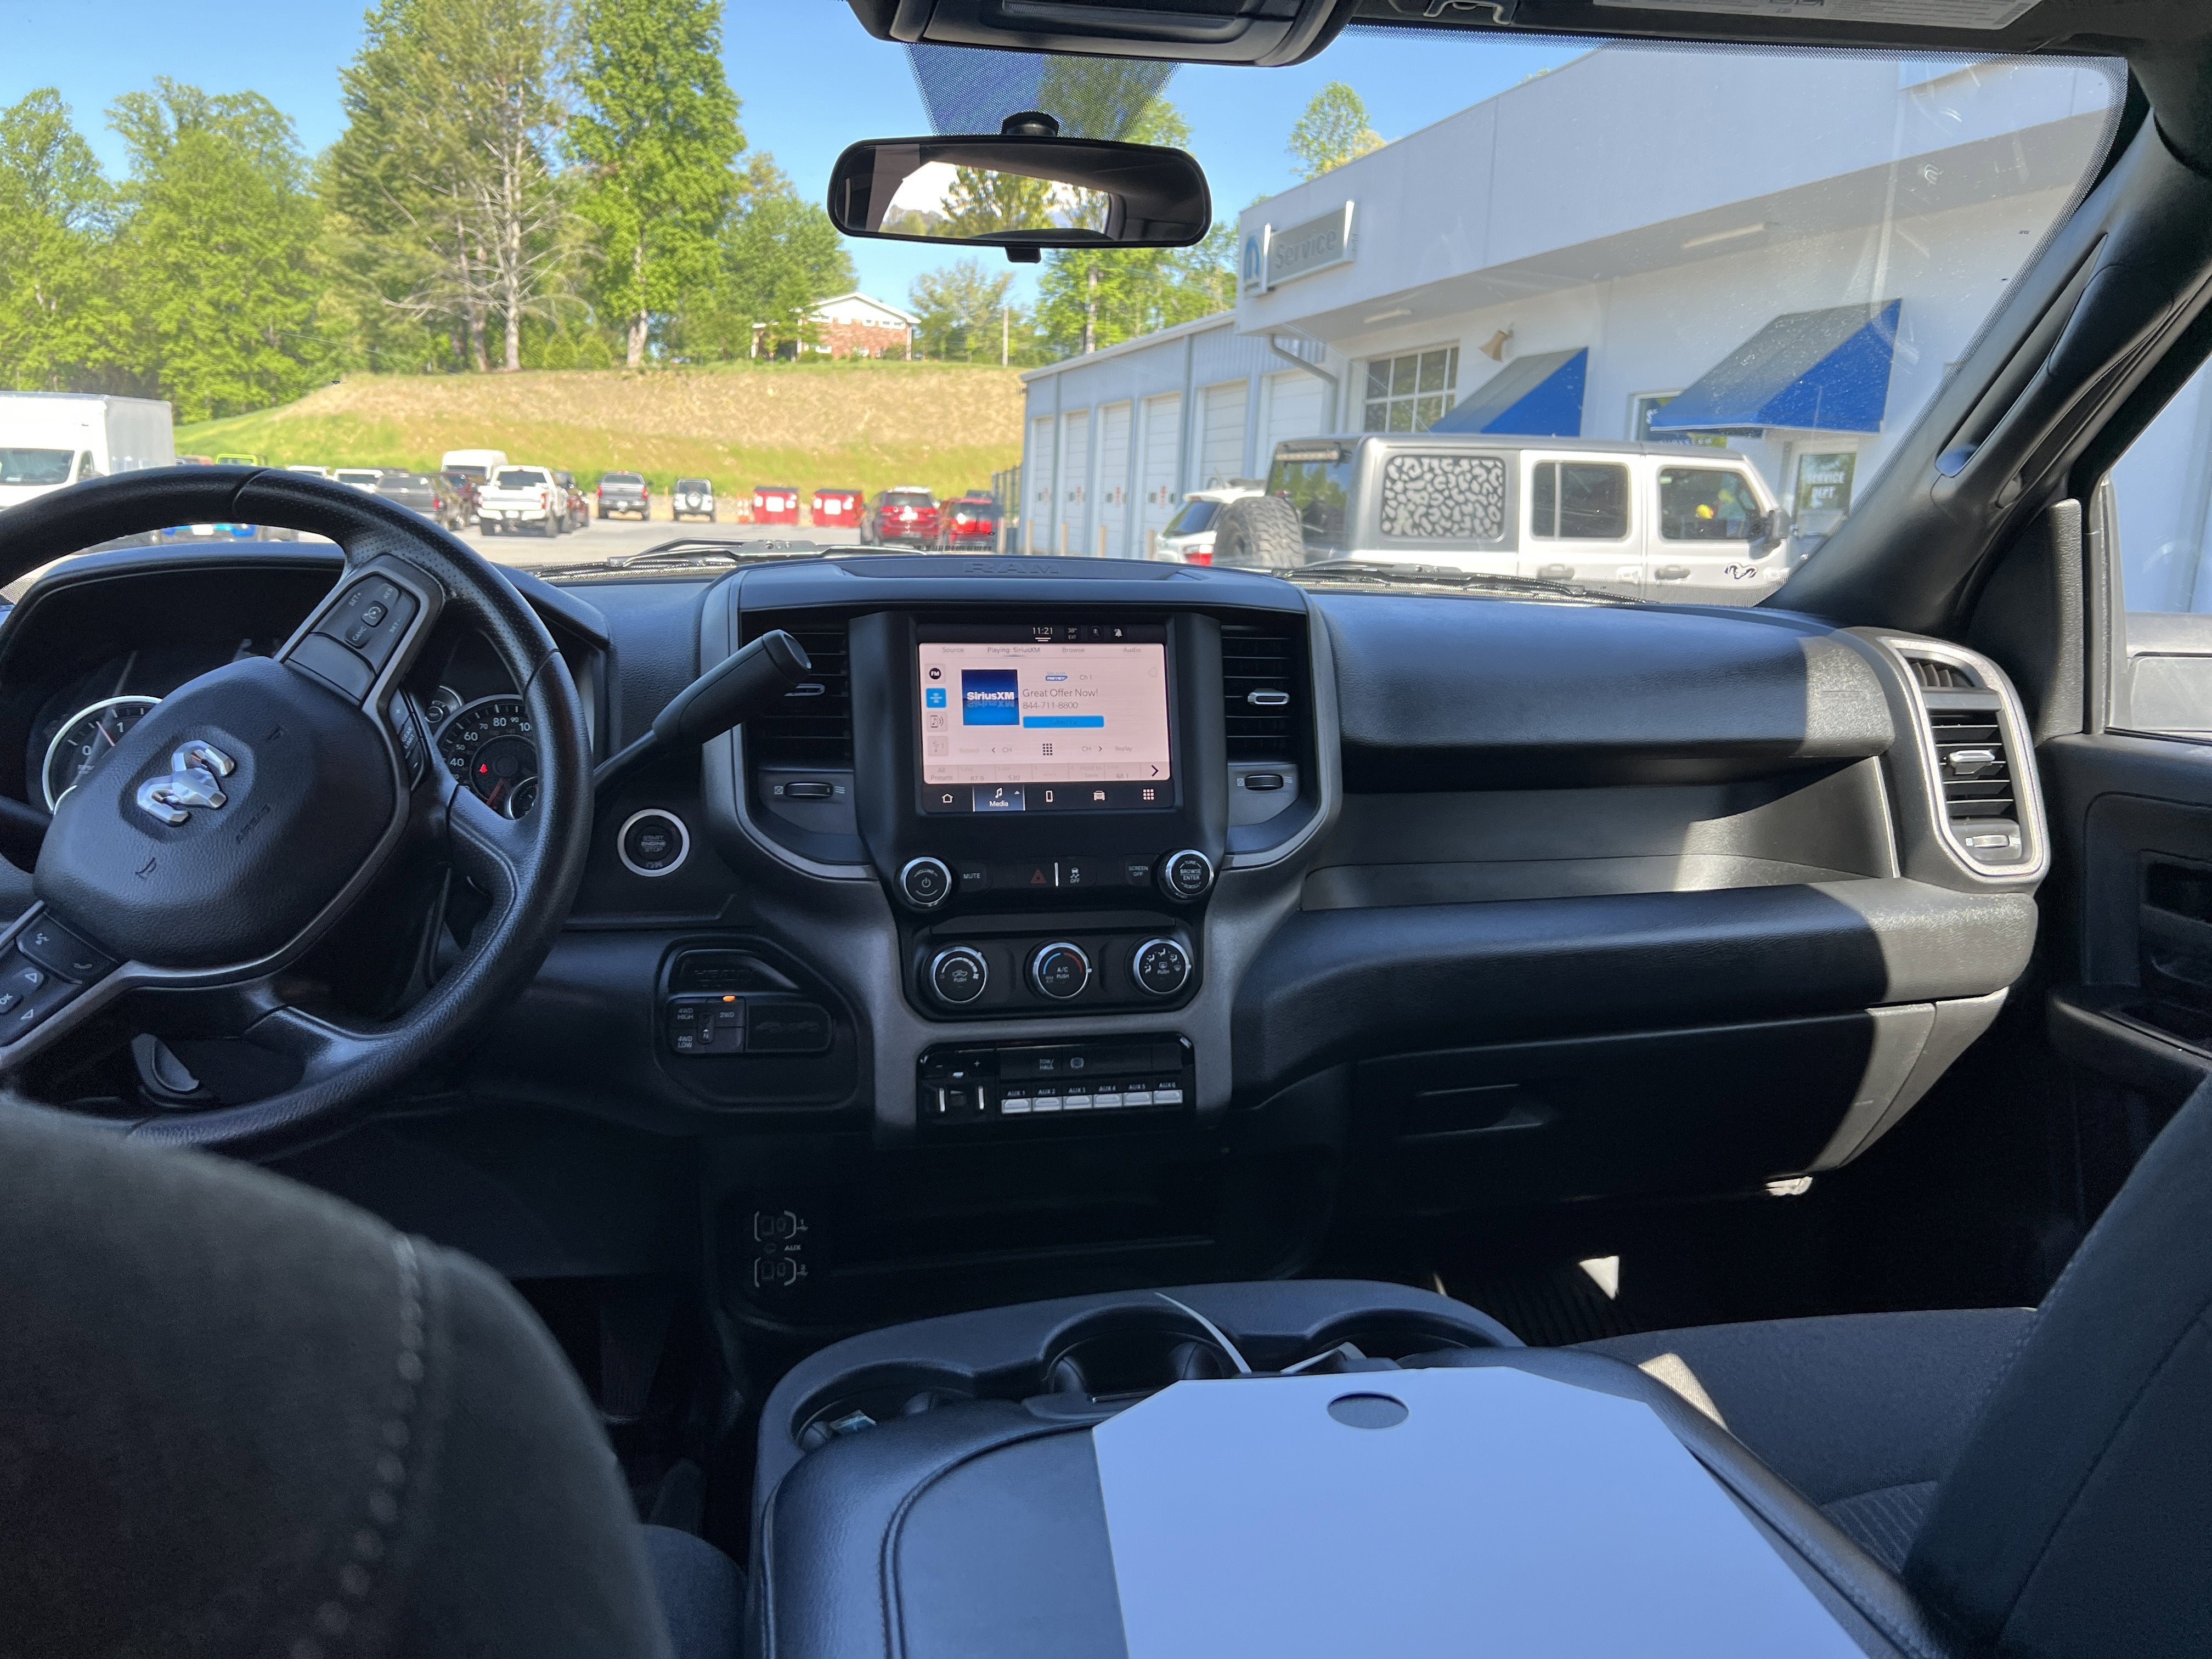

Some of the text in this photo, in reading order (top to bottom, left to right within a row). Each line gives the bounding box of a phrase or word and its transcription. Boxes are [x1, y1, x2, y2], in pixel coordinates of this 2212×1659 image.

[1274, 230, 1337, 270] Service
[964, 562, 1060, 574] RAM
[383, 588, 393, 600] RES
[967, 691, 1014, 700] SiriusXM
[1023, 689, 1098, 697] Great Offer Now!
[493, 717, 507, 726] 80
[117, 722, 124, 732] 1
[464, 732, 478, 741] 60
[82, 745, 92, 755] 0
[450, 758, 464, 766] 40
